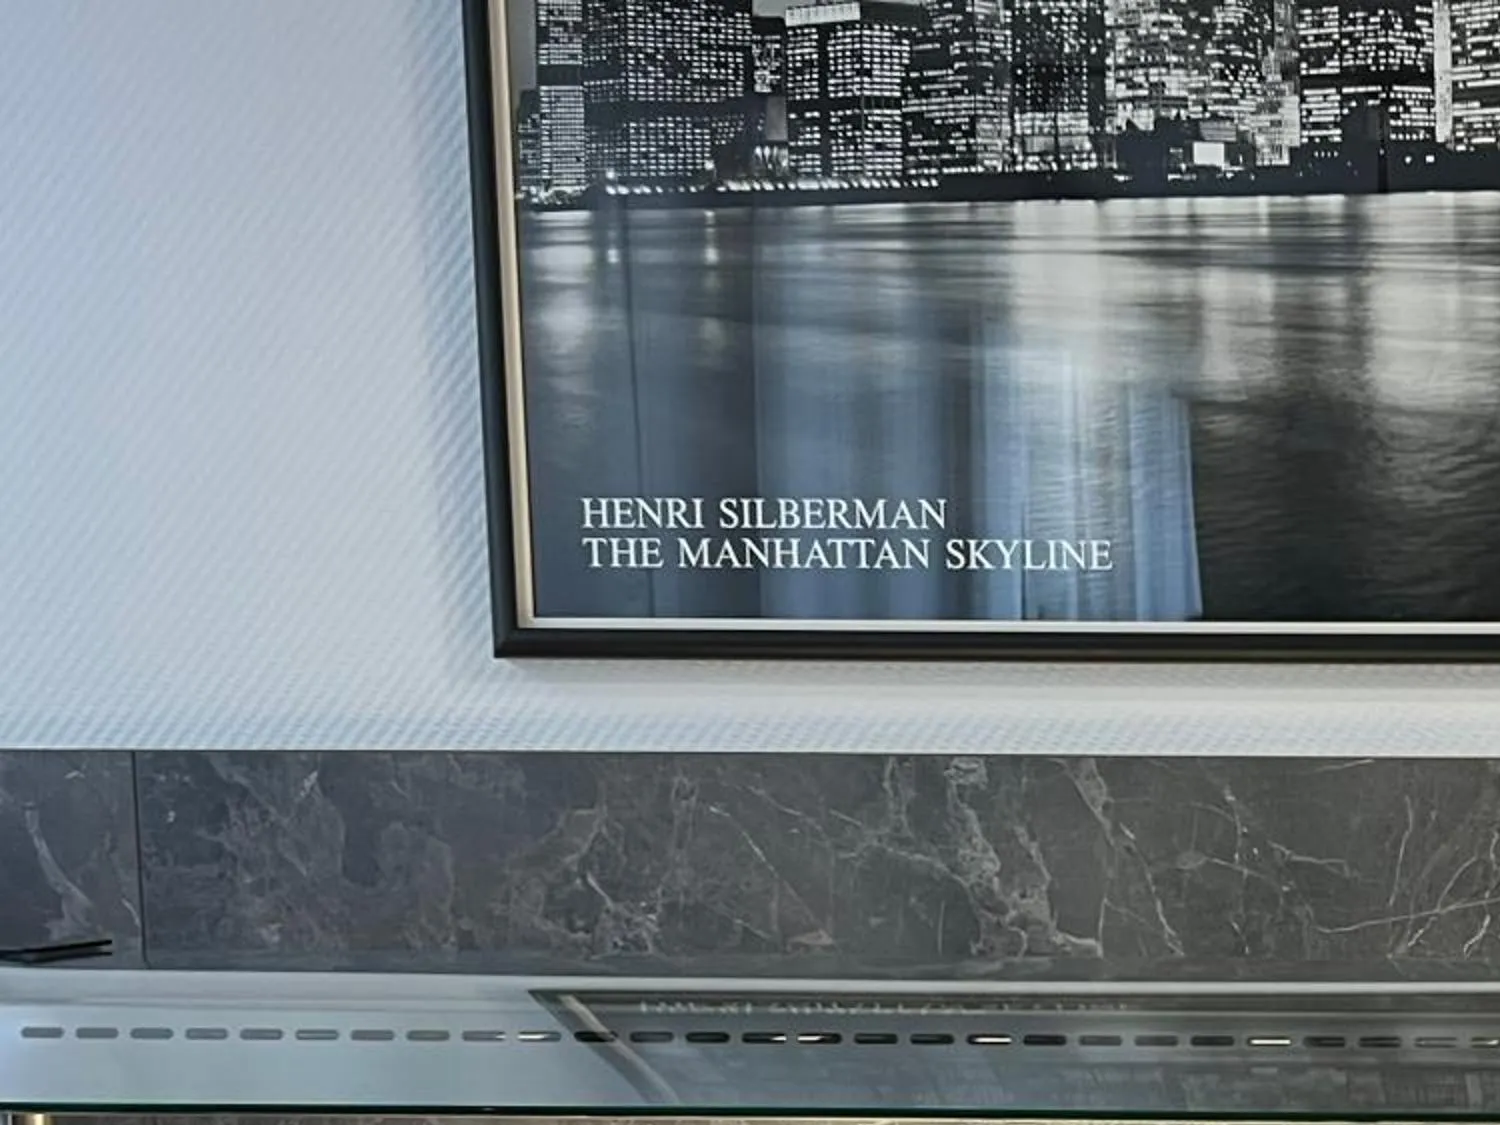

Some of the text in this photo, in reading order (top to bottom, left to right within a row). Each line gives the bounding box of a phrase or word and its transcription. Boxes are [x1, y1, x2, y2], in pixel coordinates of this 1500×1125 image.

[582, 497, 948, 530] HENRI SILBERMAN
[581, 536, 1114, 571] THE MANHATTAN SKYLINE
